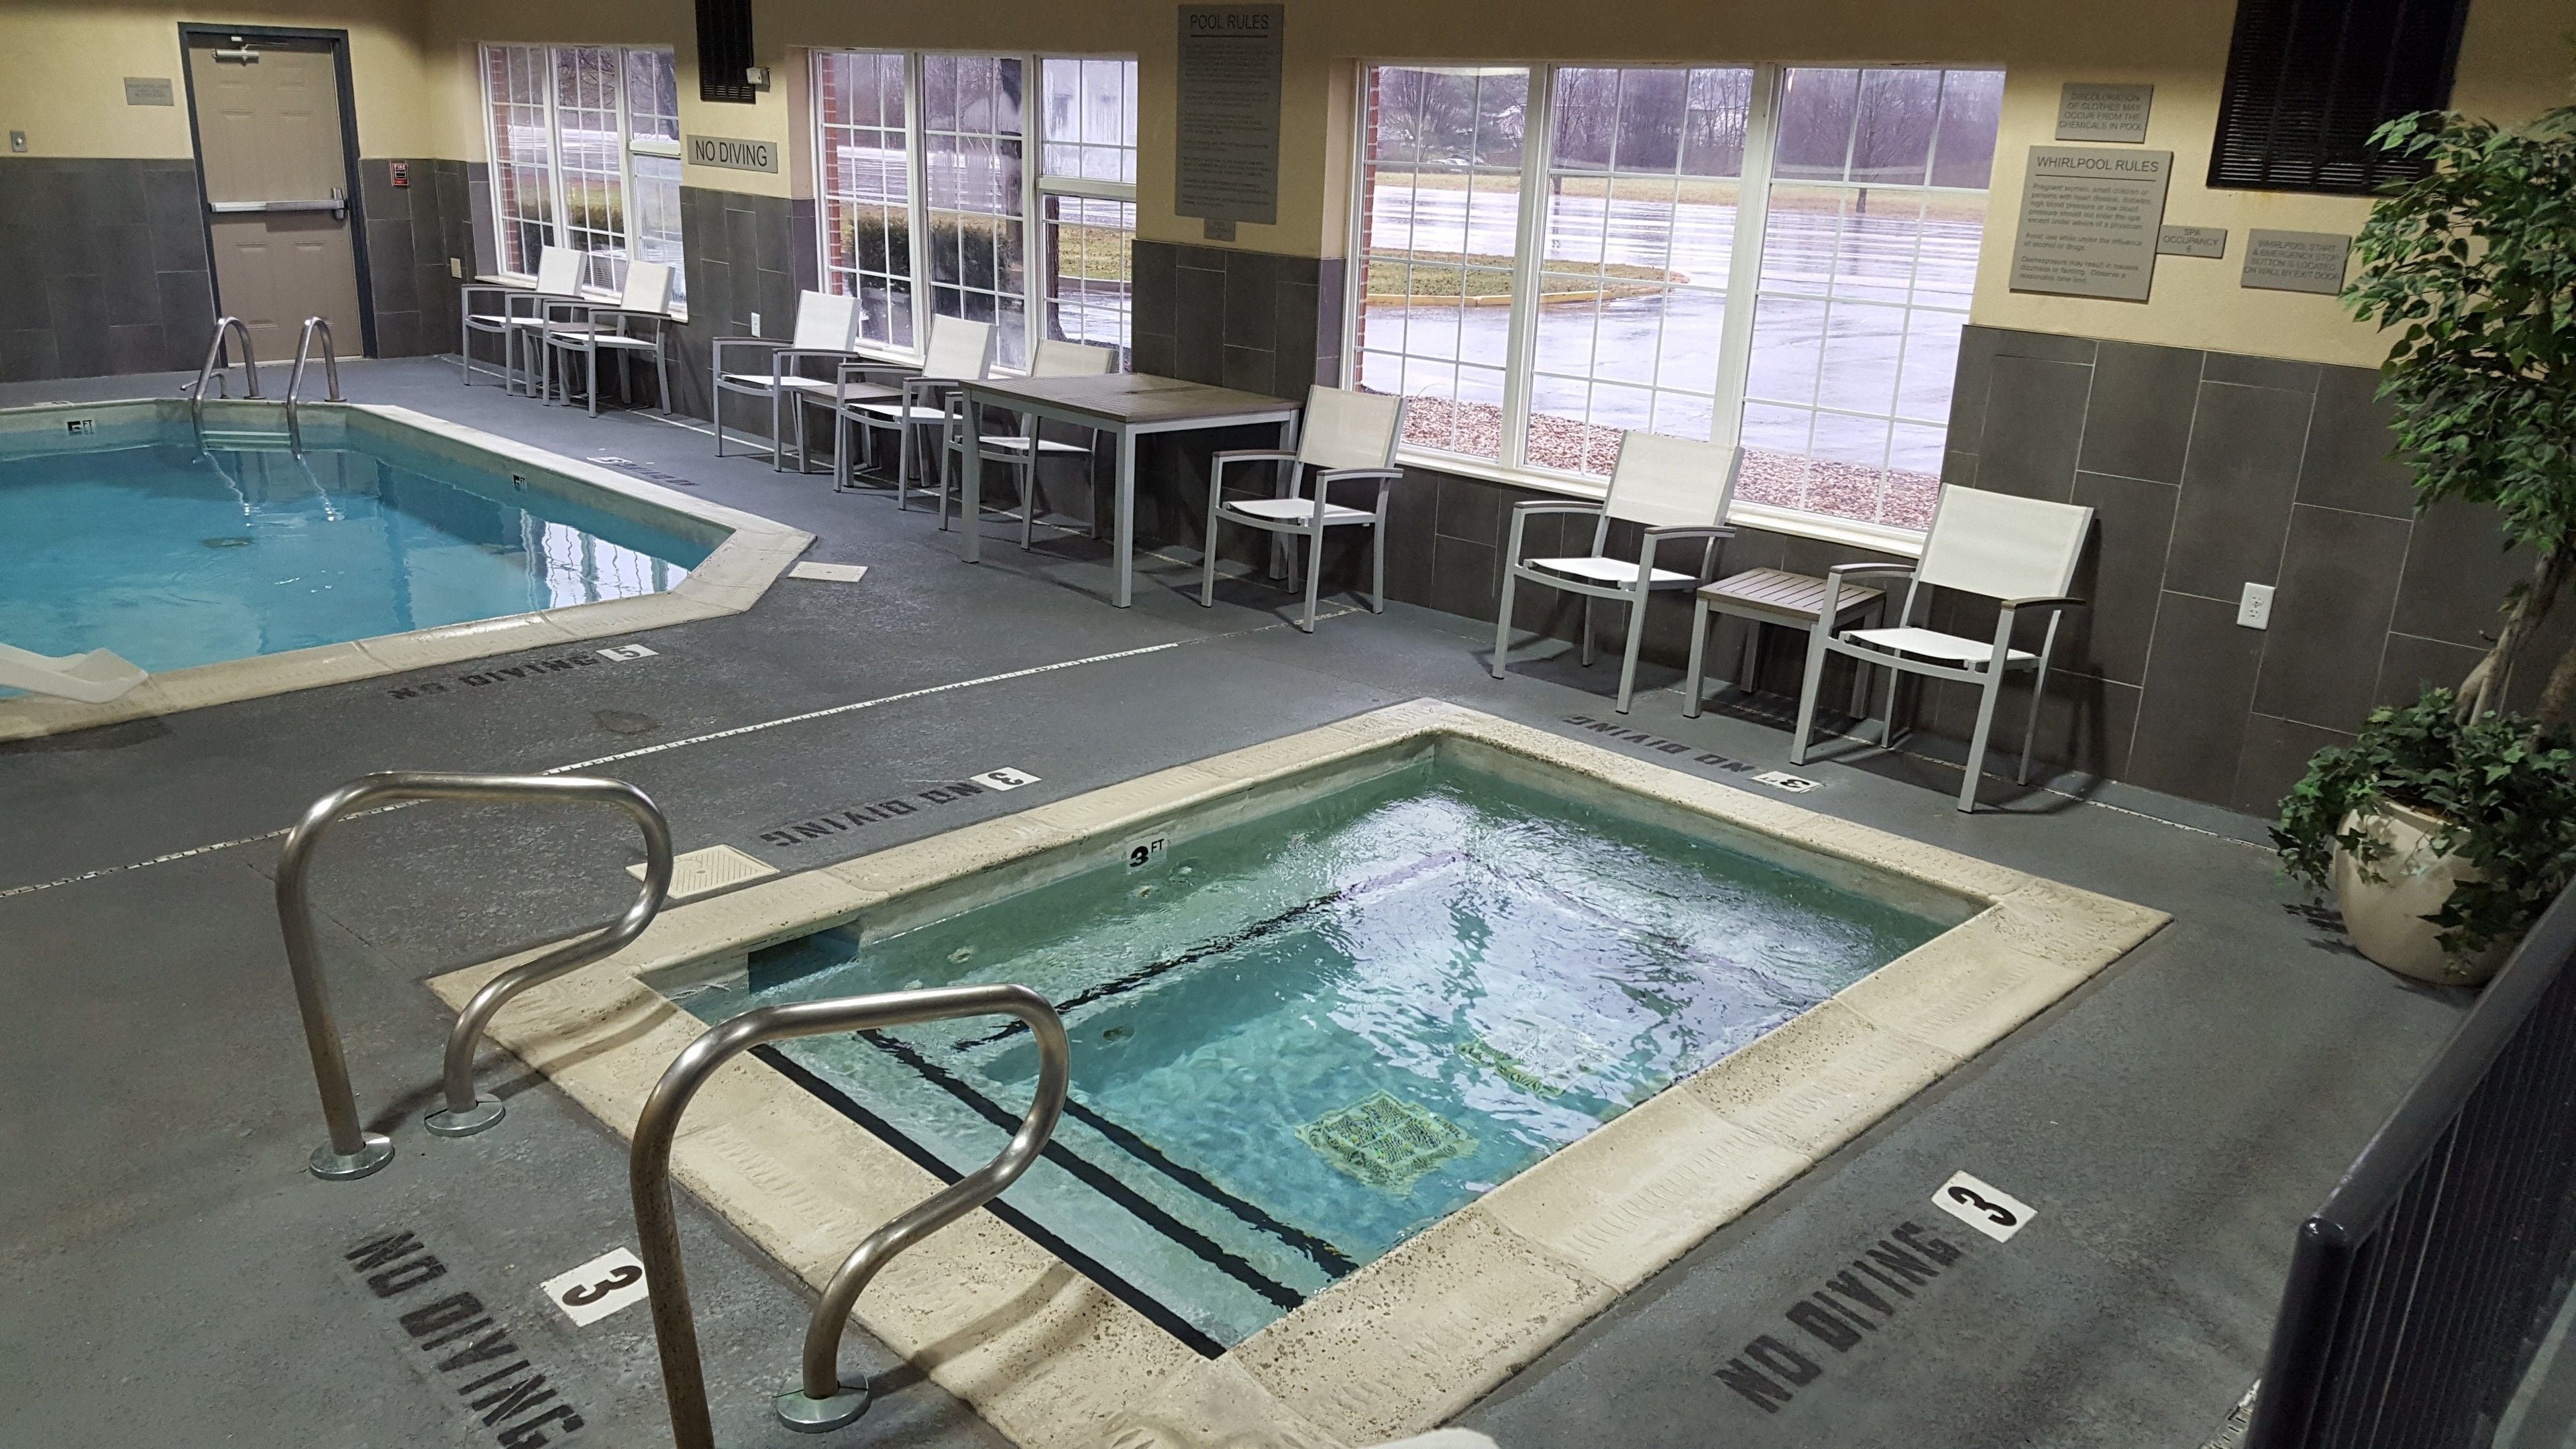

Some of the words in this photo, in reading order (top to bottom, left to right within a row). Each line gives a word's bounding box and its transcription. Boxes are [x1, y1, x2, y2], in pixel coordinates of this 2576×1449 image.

[1190, 15, 1224, 30] POOL
[1227, 15, 1269, 30] RULES
[2072, 91, 2140, 101] DISCOLORATION
[2082, 103, 2121, 111] CLOTHES
[2064, 112, 2095, 120] OCCUR
[2097, 113, 2122, 121] FROM
[2125, 113, 2141, 121] THE
[2059, 121, 2106, 130] CHEMICALS
[2109, 122, 2118, 130] IN
[2119, 123, 2143, 131] POOL
[696, 140, 715, 162] NO
[719, 142, 767, 167] DIVING
[2037, 156, 2112, 170] WHIRLPOOL
[2115, 160, 2159, 172] RULES
[2033, 183, 2063, 192] Pregnant
[2113, 187, 2139, 195] children
[2163, 235, 2218, 246] OCCUPANCY
[2259, 240, 2306, 250] WHIRLPOOL
[2310, 244, 2337, 252] START
[2021, 256, 2068, 266] Overexposure
[2261, 249, 2314, 259] EMERGENCY
[2315, 253, 2340, 262] STOP
[2252, 258, 2286, 267] BUTTON
[2296, 261, 2336, 271] LOCATED
[2091, 269, 2120, 278] Observe
[2257, 268, 2281, 276] WALL
[2314, 272, 2341, 280] DOOR
[612, 647, 641, 658] 5
[458, 653, 600, 686] DIVING
[1562, 715, 1692, 755] DIVING
[1694, 753, 1755, 773] NO
[987, 771, 1024, 786] 3
[1780, 779, 1811, 788] 3
[918, 782, 984, 804] NO
[759, 799, 918, 847] DIVING
[1129, 845, 1149, 868] 3
[1152, 838, 1165, 853] FT
[1947, 1185, 2019, 1227] 3
[561, 1264, 643, 1307] 3
[1713, 1334, 1823, 1414] NO
[1785, 1220, 1966, 1352] DIVING
[343, 1229, 448, 1298] NO
[398, 1290, 586, 1449] DIVING
